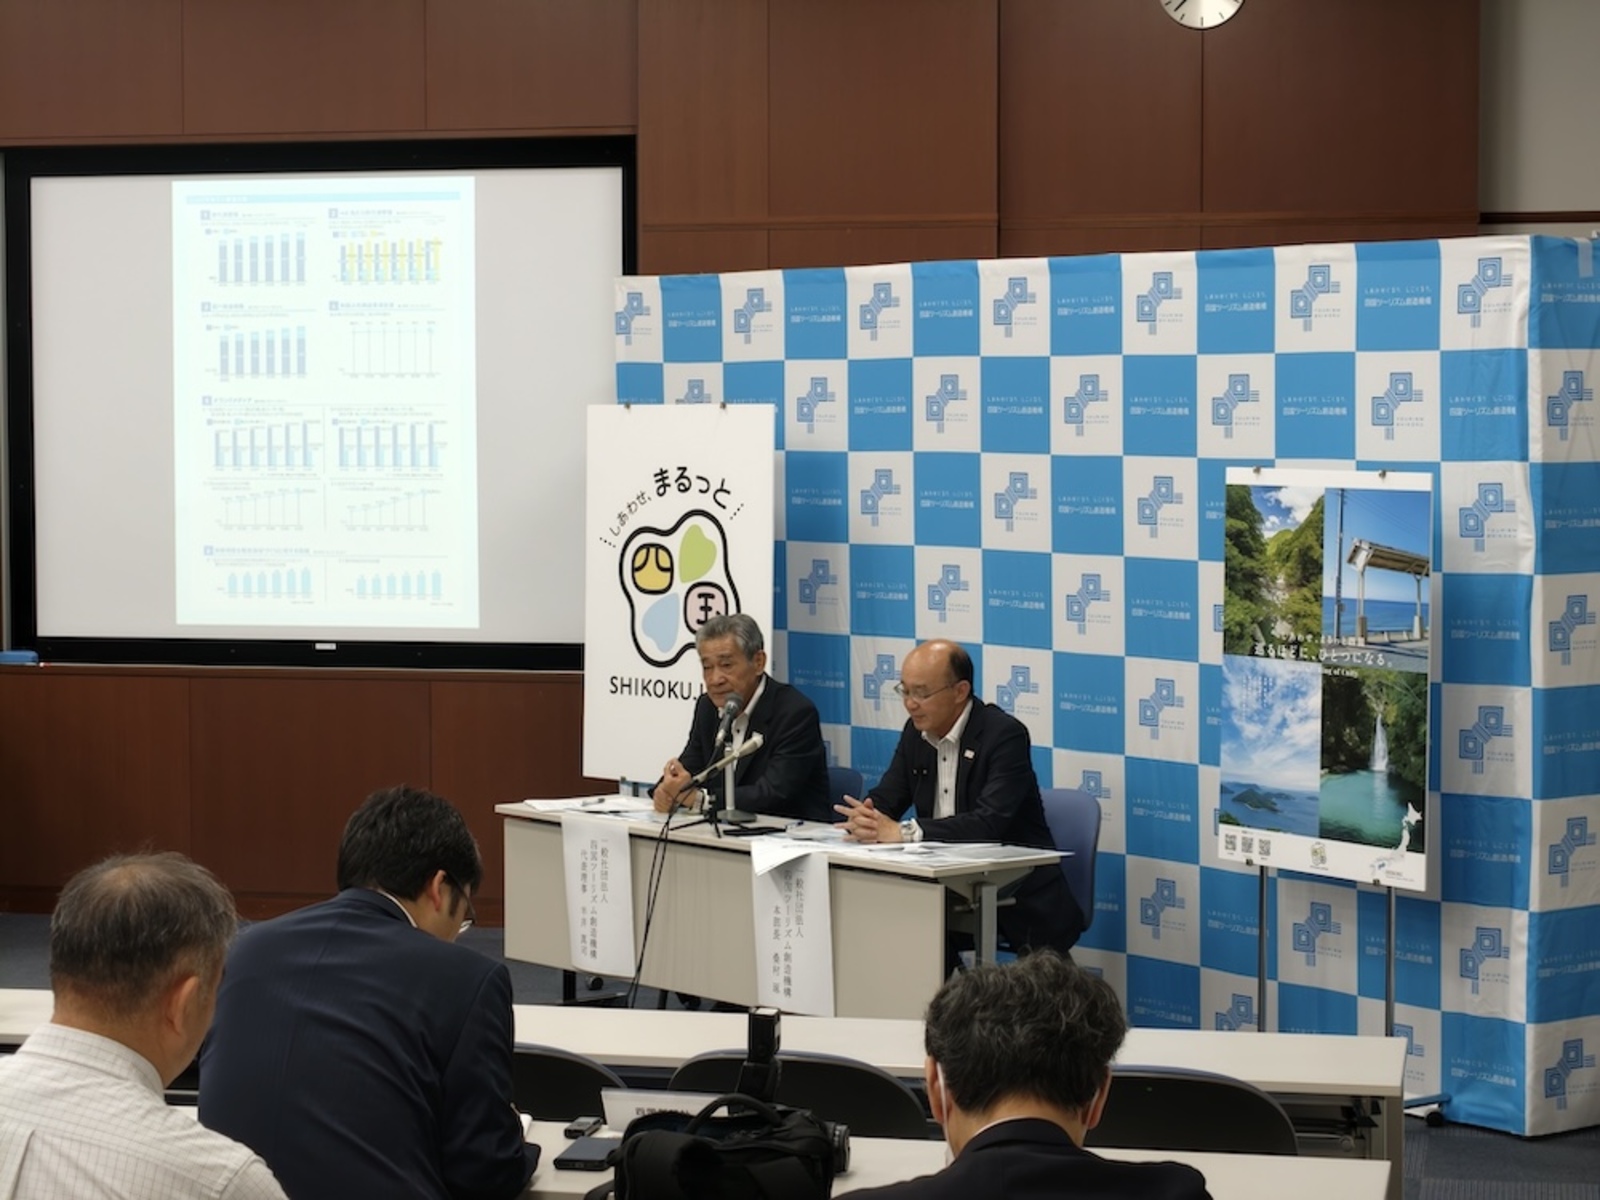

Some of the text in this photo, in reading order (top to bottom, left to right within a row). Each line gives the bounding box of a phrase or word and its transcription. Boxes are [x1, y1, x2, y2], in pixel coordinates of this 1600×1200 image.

[610, 466, 732, 537] しあわせ、 まるっと
[600, 838, 609, 904] 一般社団法人
